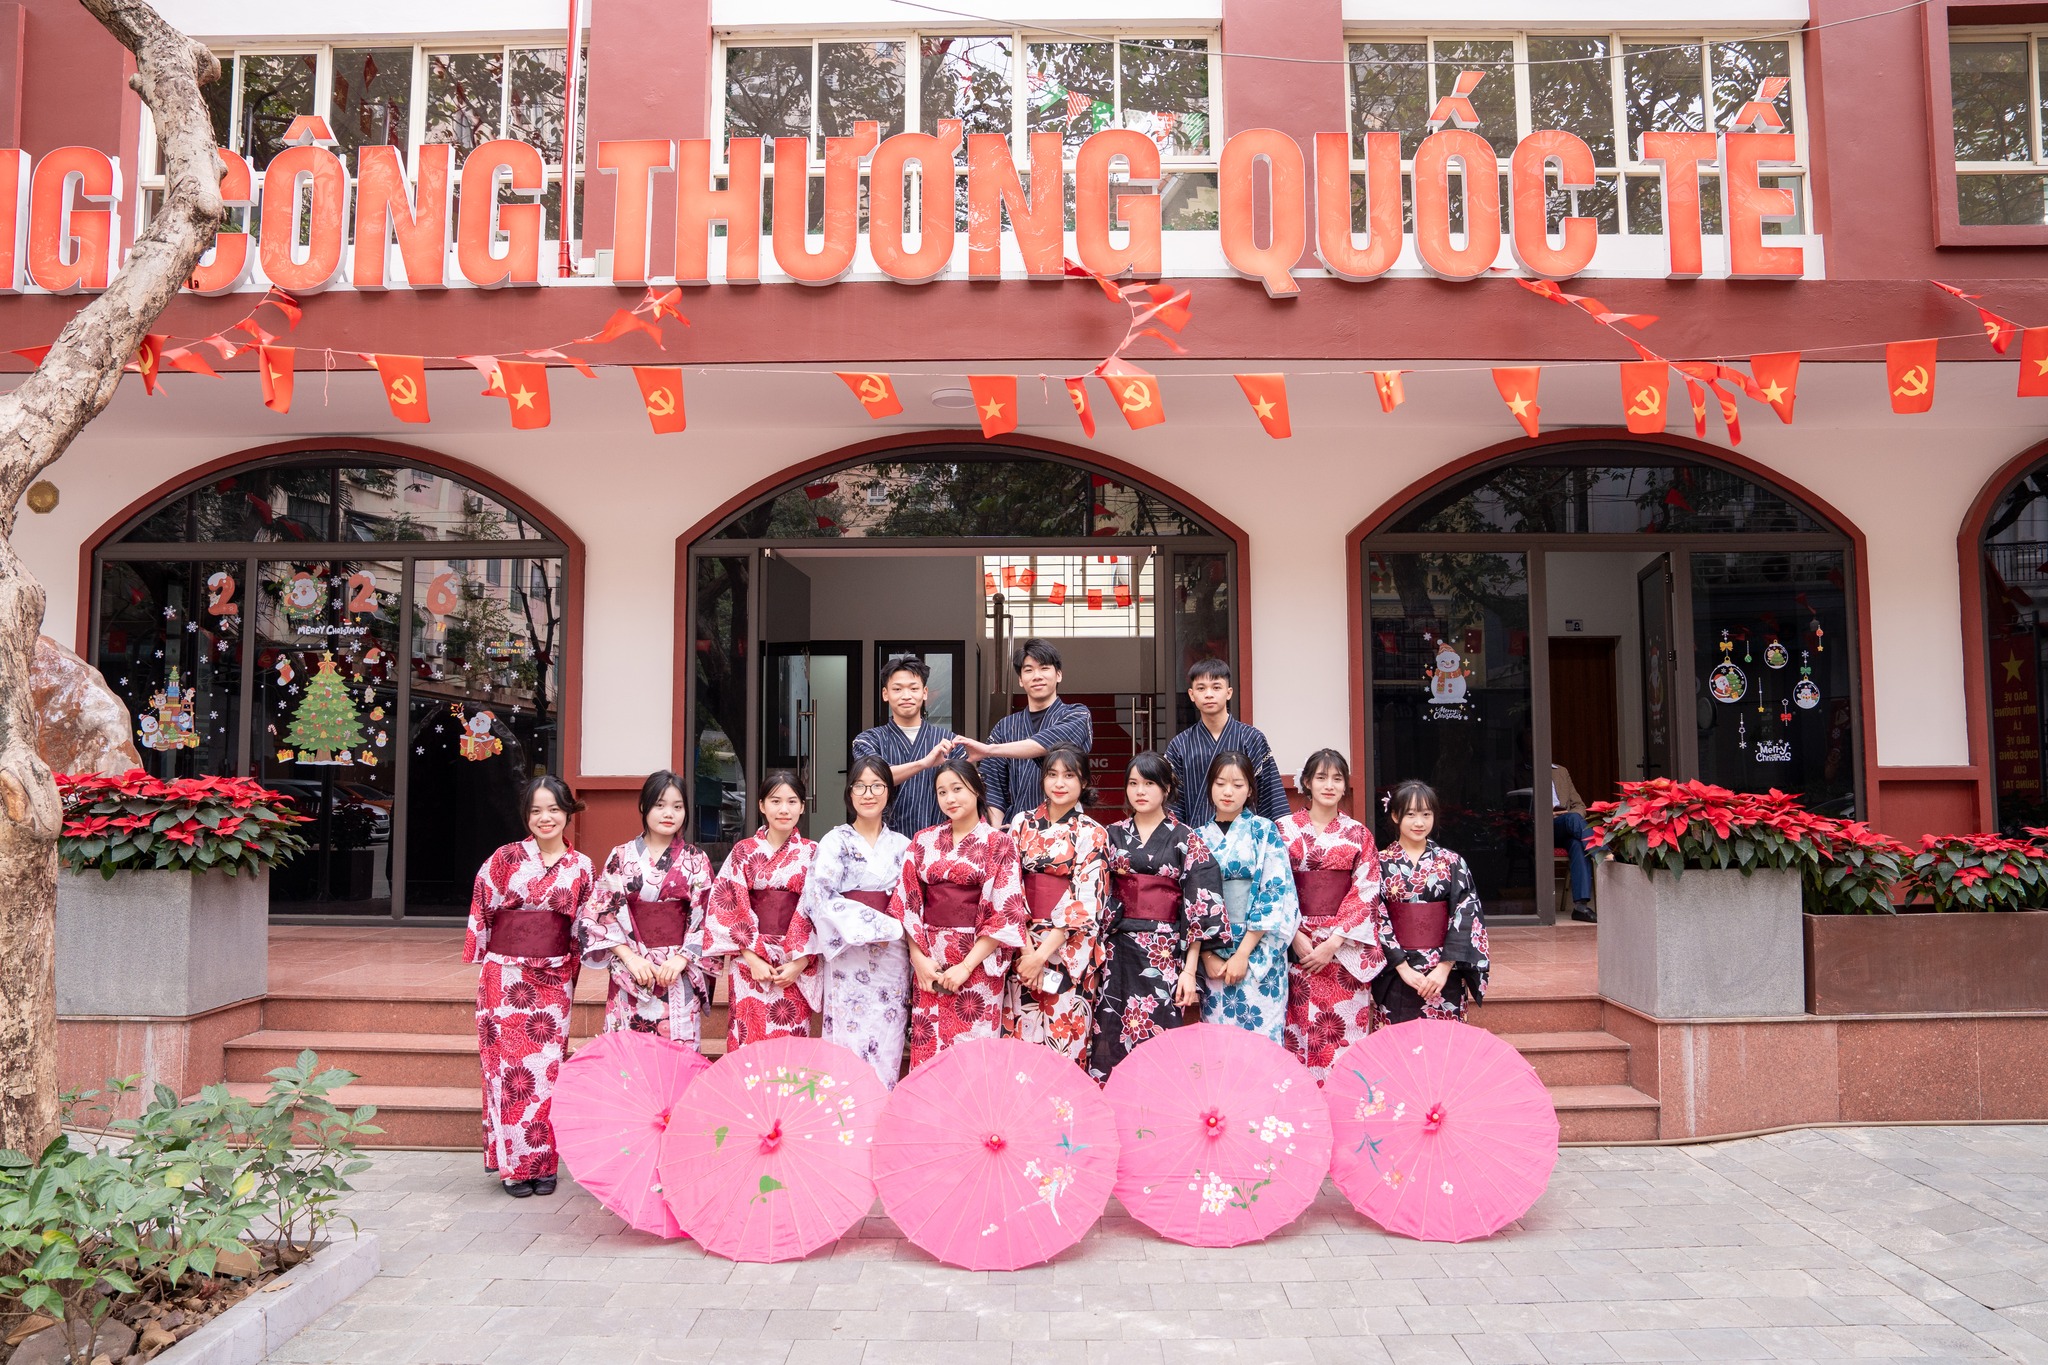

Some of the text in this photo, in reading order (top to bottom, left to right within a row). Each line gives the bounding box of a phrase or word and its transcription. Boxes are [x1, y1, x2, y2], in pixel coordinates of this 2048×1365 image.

[182, 115, 547, 295] CÔNG
[597, 118, 1162, 287] THƯƠNG
[1217, 70, 1598, 299] QUỐC
[1638, 76, 1804, 281] TẾ
[297, 625, 326, 635] MERRY
[486, 647, 525, 655] CHRISTMAS
[1757, 741, 1790, 755] Merry
[1089, 758, 1109, 768] NG
